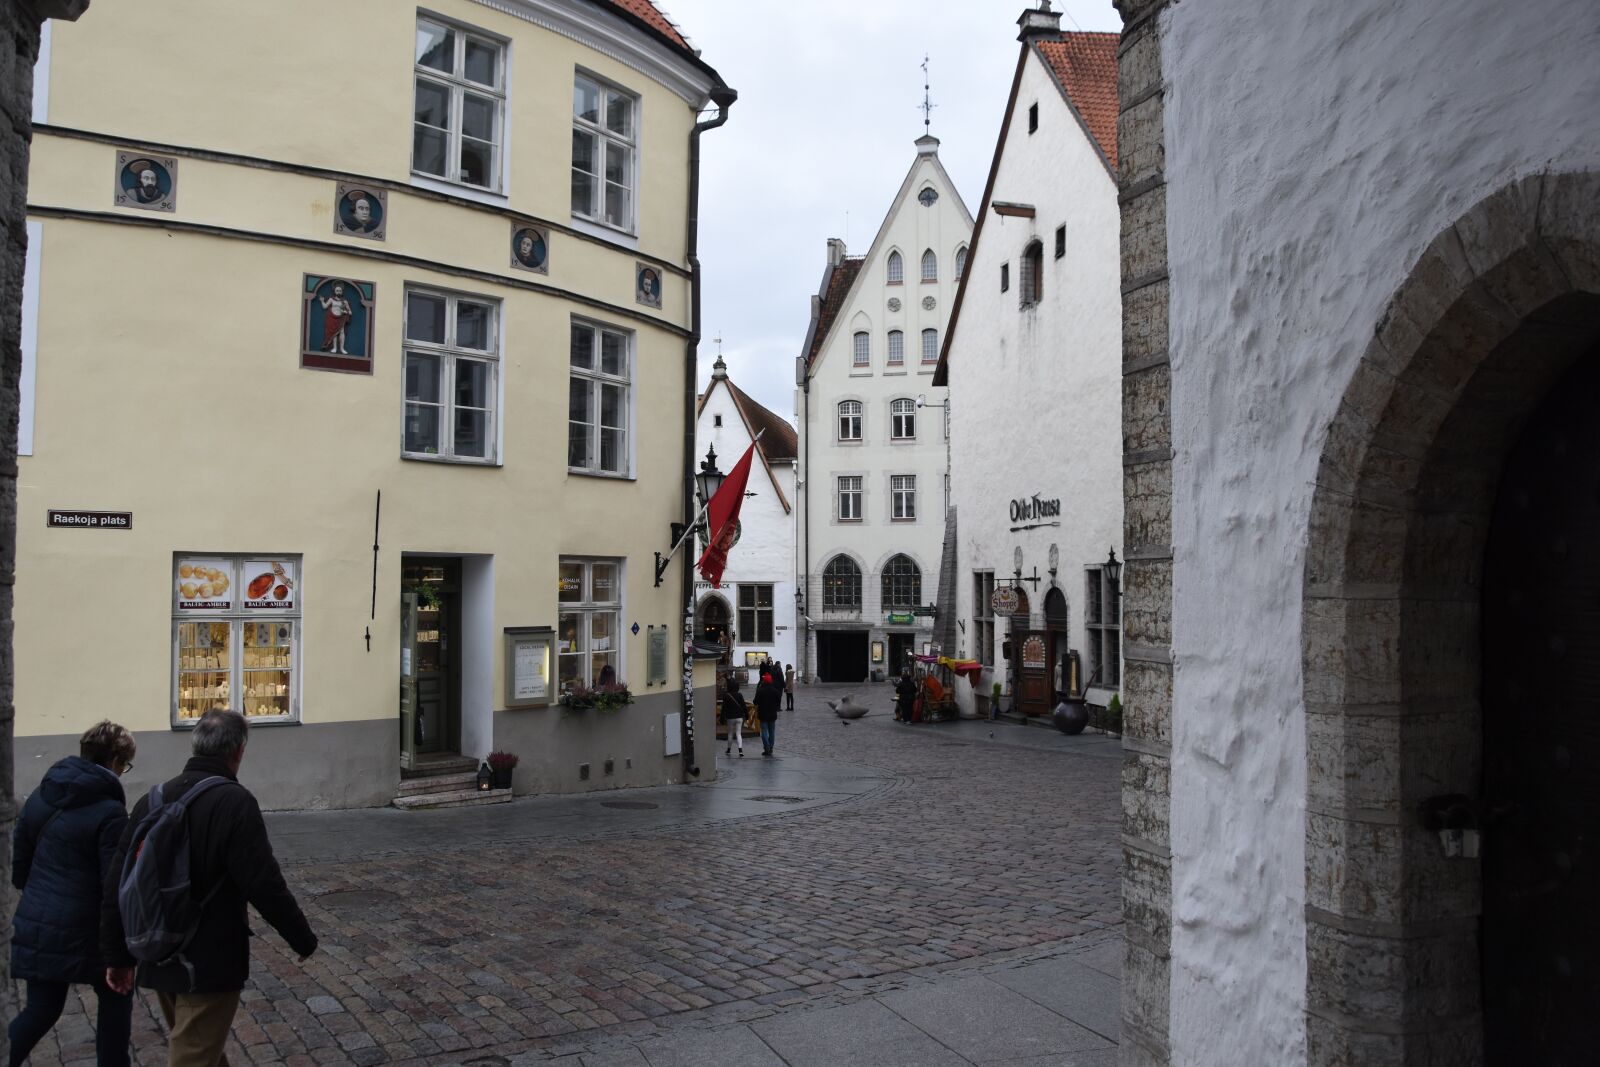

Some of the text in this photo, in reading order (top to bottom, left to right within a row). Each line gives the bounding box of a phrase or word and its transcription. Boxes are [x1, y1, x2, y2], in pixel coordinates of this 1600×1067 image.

[120, 155, 173, 168] S M
[116, 194, 173, 210] 15 96
[378, 192, 384, 200] L
[335, 223, 383, 239] 15 96
[53, 514, 127, 526] Raekoja plats
[992, 598, 1017, 609] Shoppe
